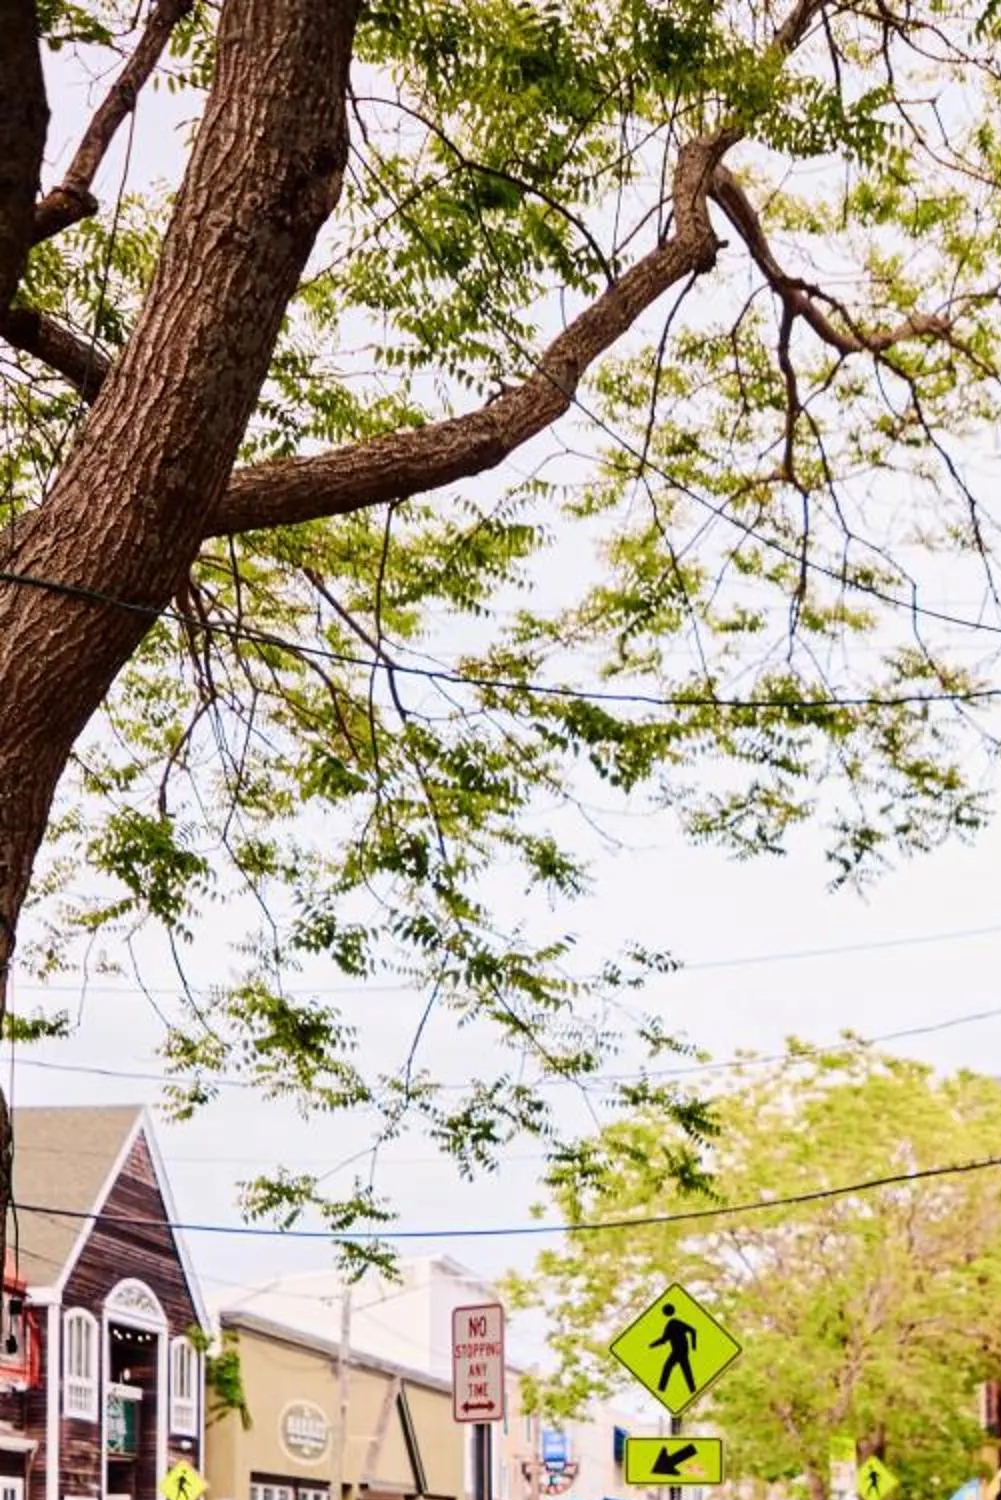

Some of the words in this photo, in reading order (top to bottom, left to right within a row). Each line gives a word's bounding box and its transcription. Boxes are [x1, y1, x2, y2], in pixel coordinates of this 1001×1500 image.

[468, 1315, 488, 1337] NO
[454, 1343, 502, 1359] STOPPING
[468, 1363, 488, 1377] ANY
[468, 1382, 489, 1397] TIME
